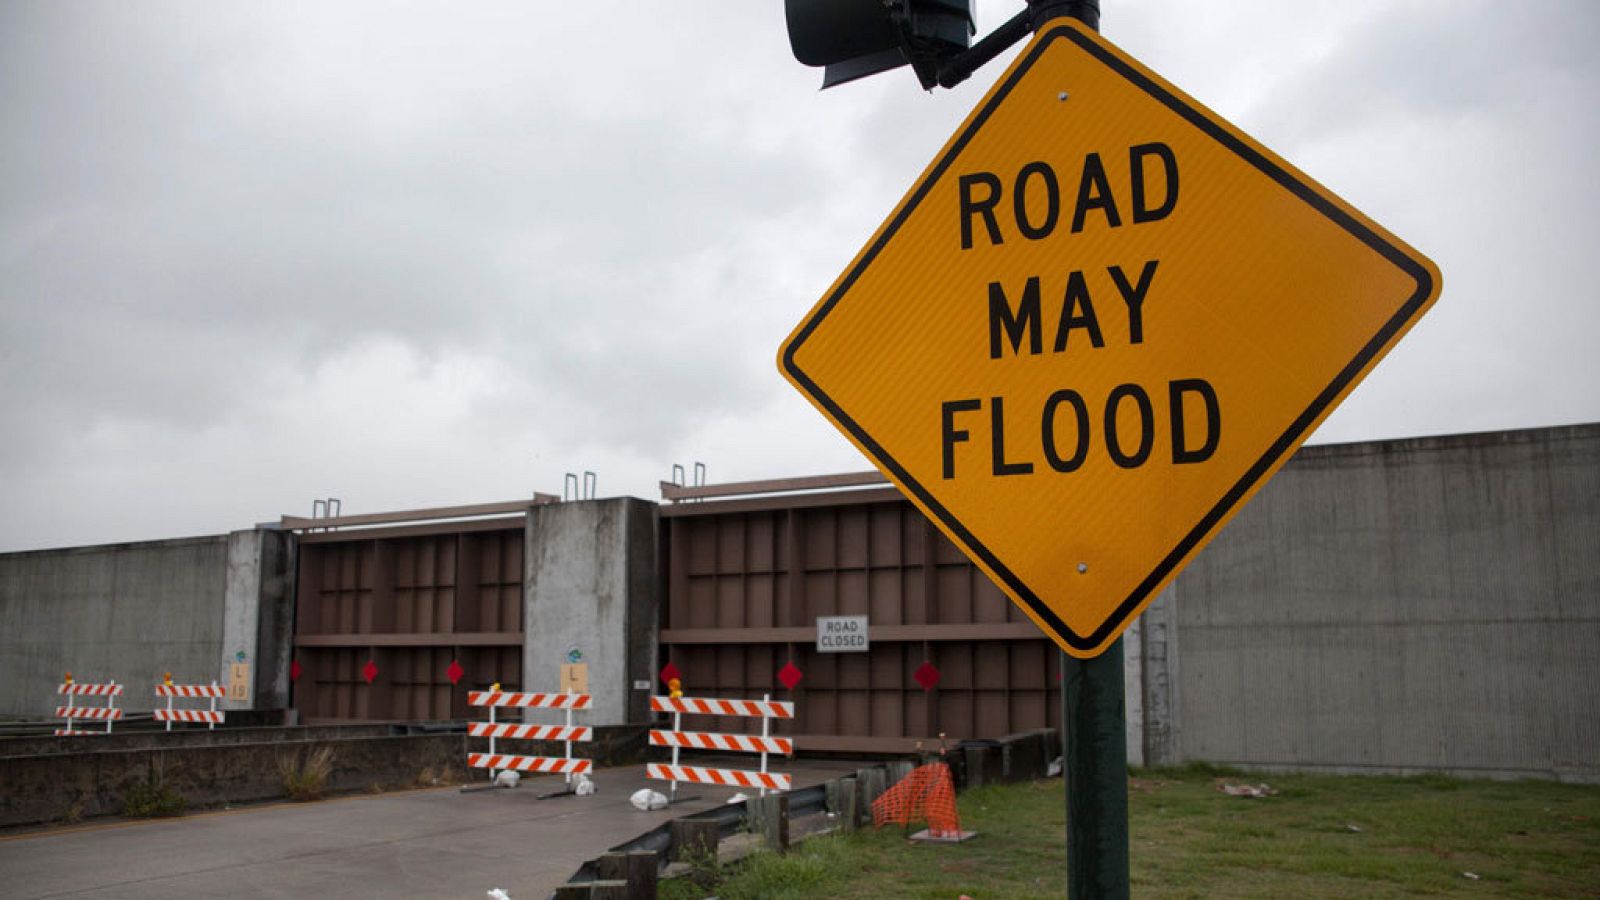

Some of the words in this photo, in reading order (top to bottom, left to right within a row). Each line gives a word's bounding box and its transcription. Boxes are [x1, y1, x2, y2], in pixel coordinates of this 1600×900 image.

[959, 142, 1179, 250] ROAD
[989, 260, 1159, 359] MAY
[942, 378, 1221, 479] FLOOD
[826, 621, 858, 633] ROAD
[821, 635, 865, 647] CLOSED
[235, 665, 242, 678] L
[569, 666, 579, 681] L
